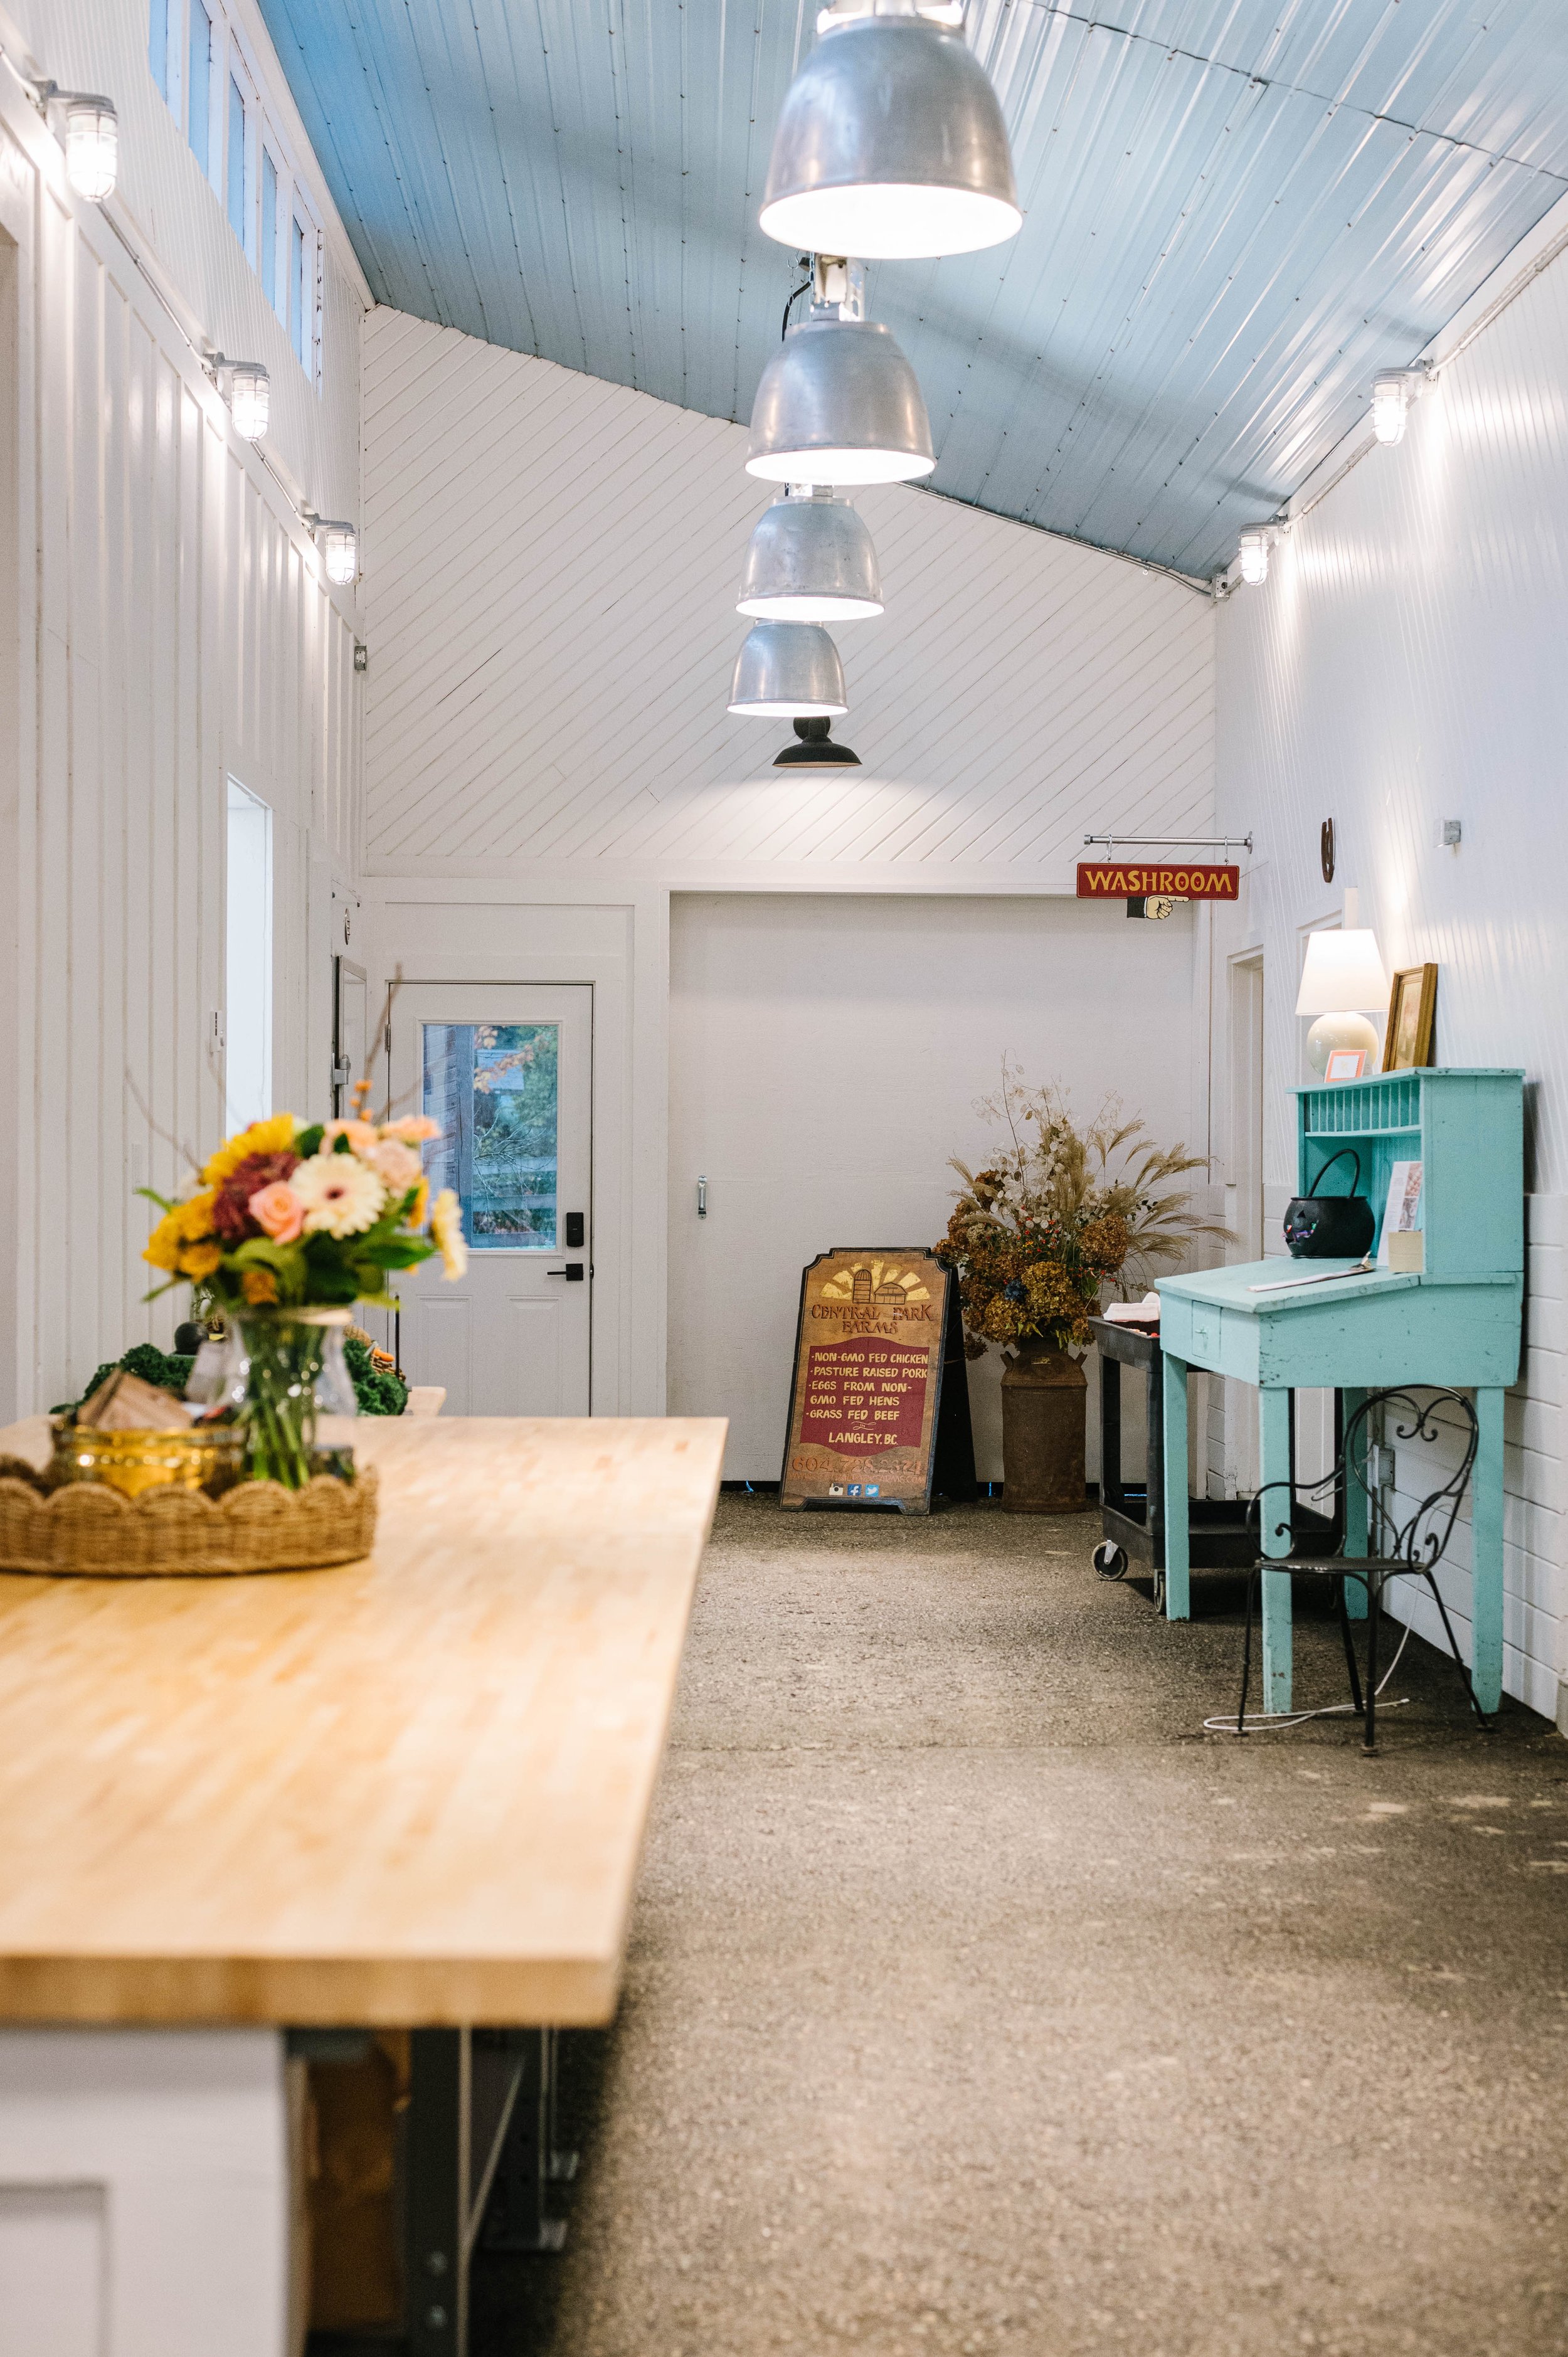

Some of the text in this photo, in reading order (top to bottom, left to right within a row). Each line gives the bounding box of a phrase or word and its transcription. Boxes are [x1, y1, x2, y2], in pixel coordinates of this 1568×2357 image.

[1084, 870, 1233, 892] WASHROOM
[812, 1305, 934, 1321] CENTRAL PARK
[842, 1320, 898, 1334] FARMS
[869, 1353, 887, 1362] FED
[890, 1354, 928, 1364] CHICKEN
[862, 1368, 898, 1377] RAISED
[902, 1369, 928, 1378] PORK
[844, 1382, 875, 1391] FROM
[810, 1396, 899, 1406] GMO FED HENS
[848, 1410, 868, 1420] FED
[874, 1411, 899, 1421] BEEF
